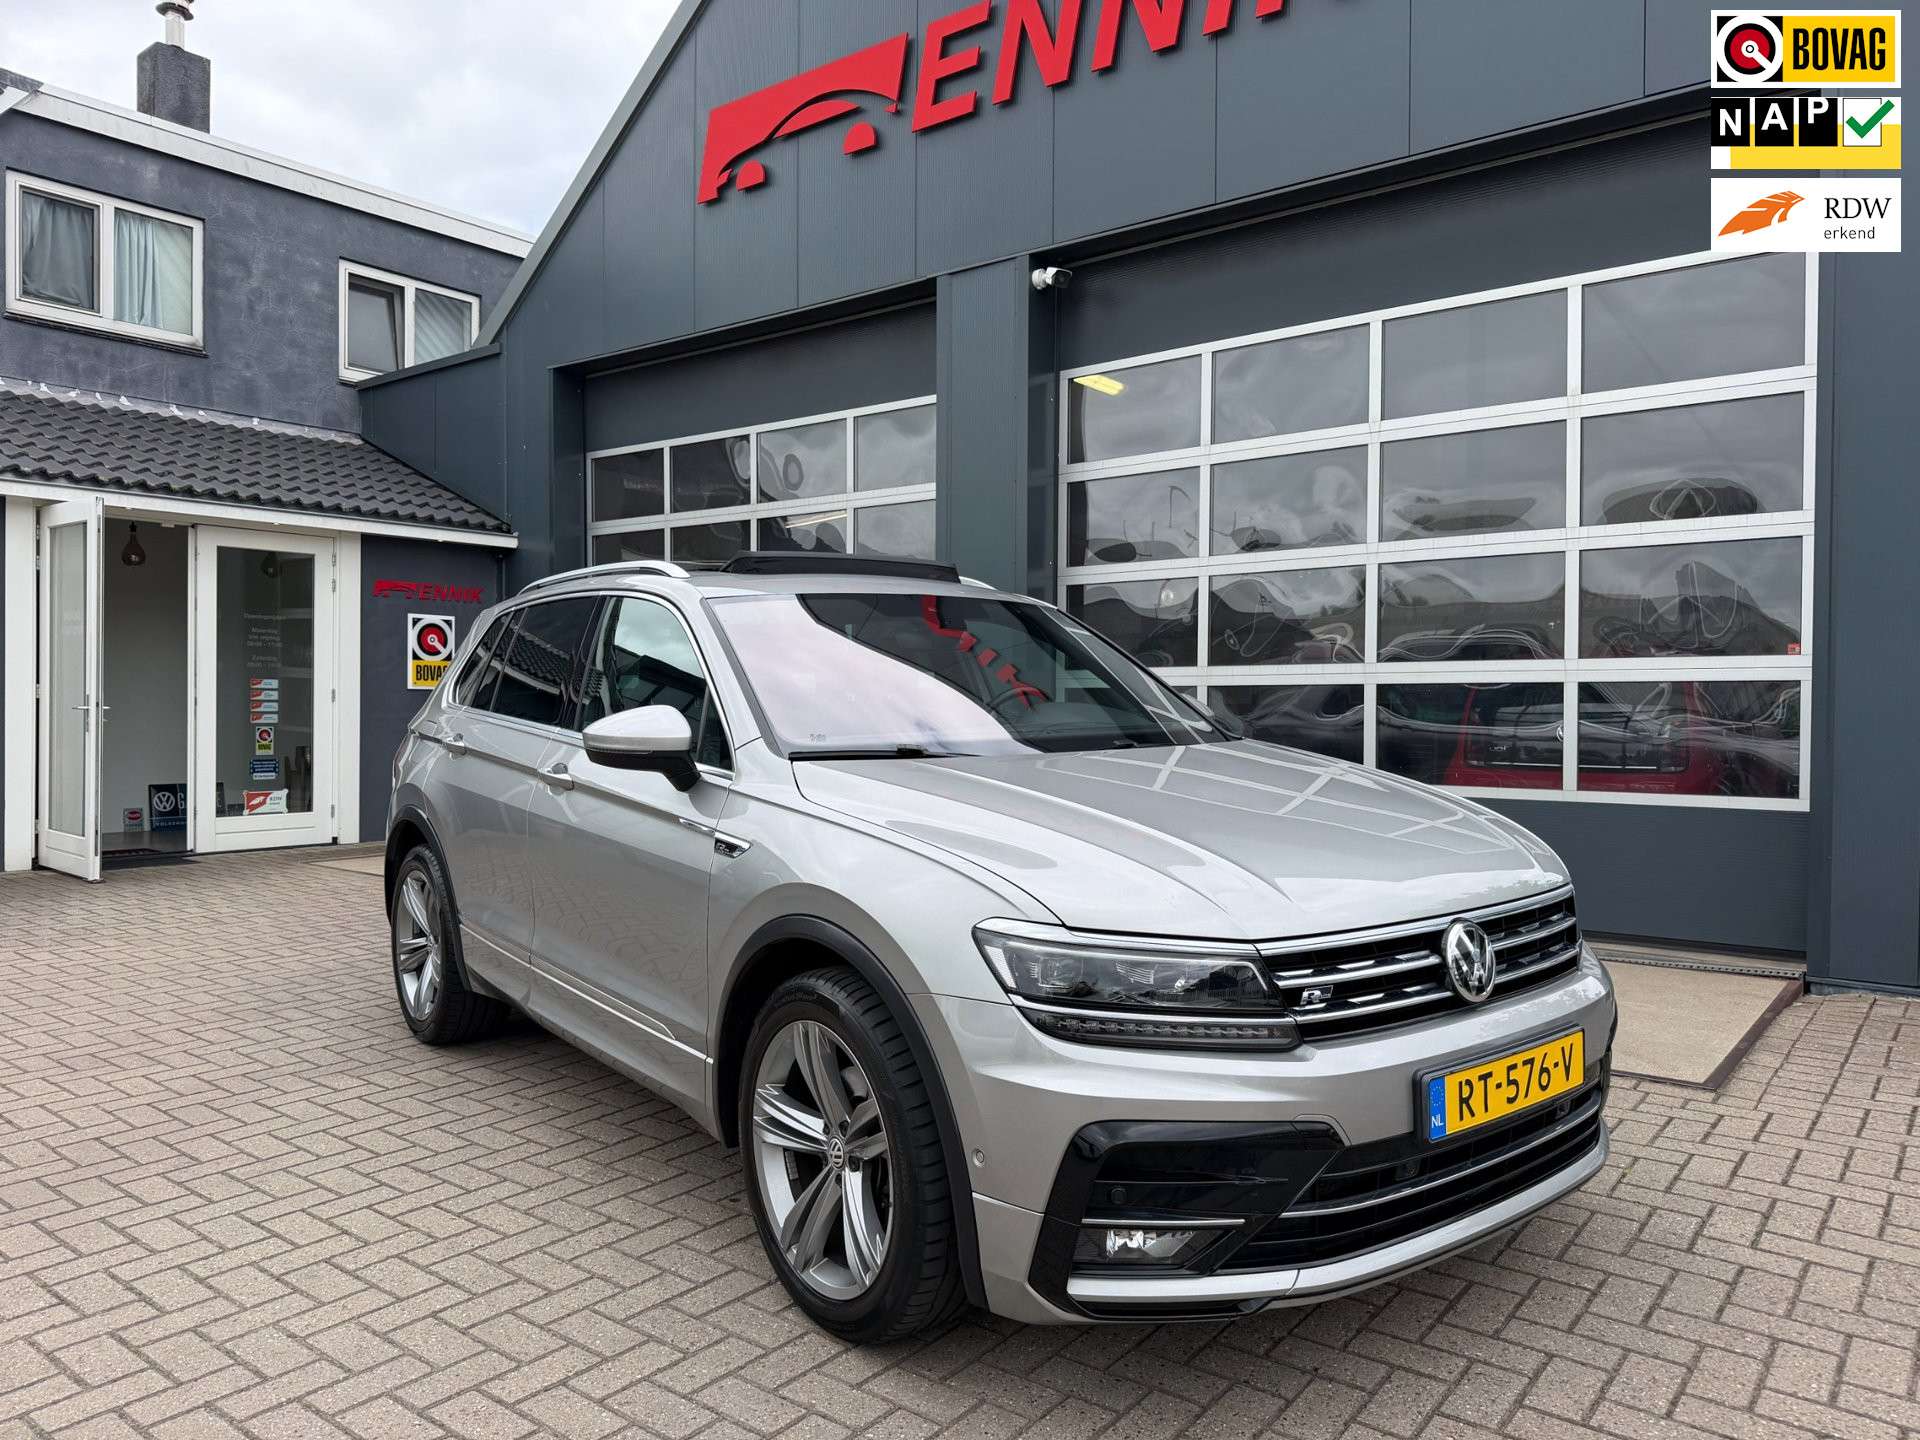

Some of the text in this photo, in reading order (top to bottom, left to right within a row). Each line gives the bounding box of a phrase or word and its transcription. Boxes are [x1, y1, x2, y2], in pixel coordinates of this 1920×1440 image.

[911, 0, 1285, 133] ENN
[1431, 1114, 1444, 1129] NL
[1457, 1043, 1573, 1122] RT-576-V
